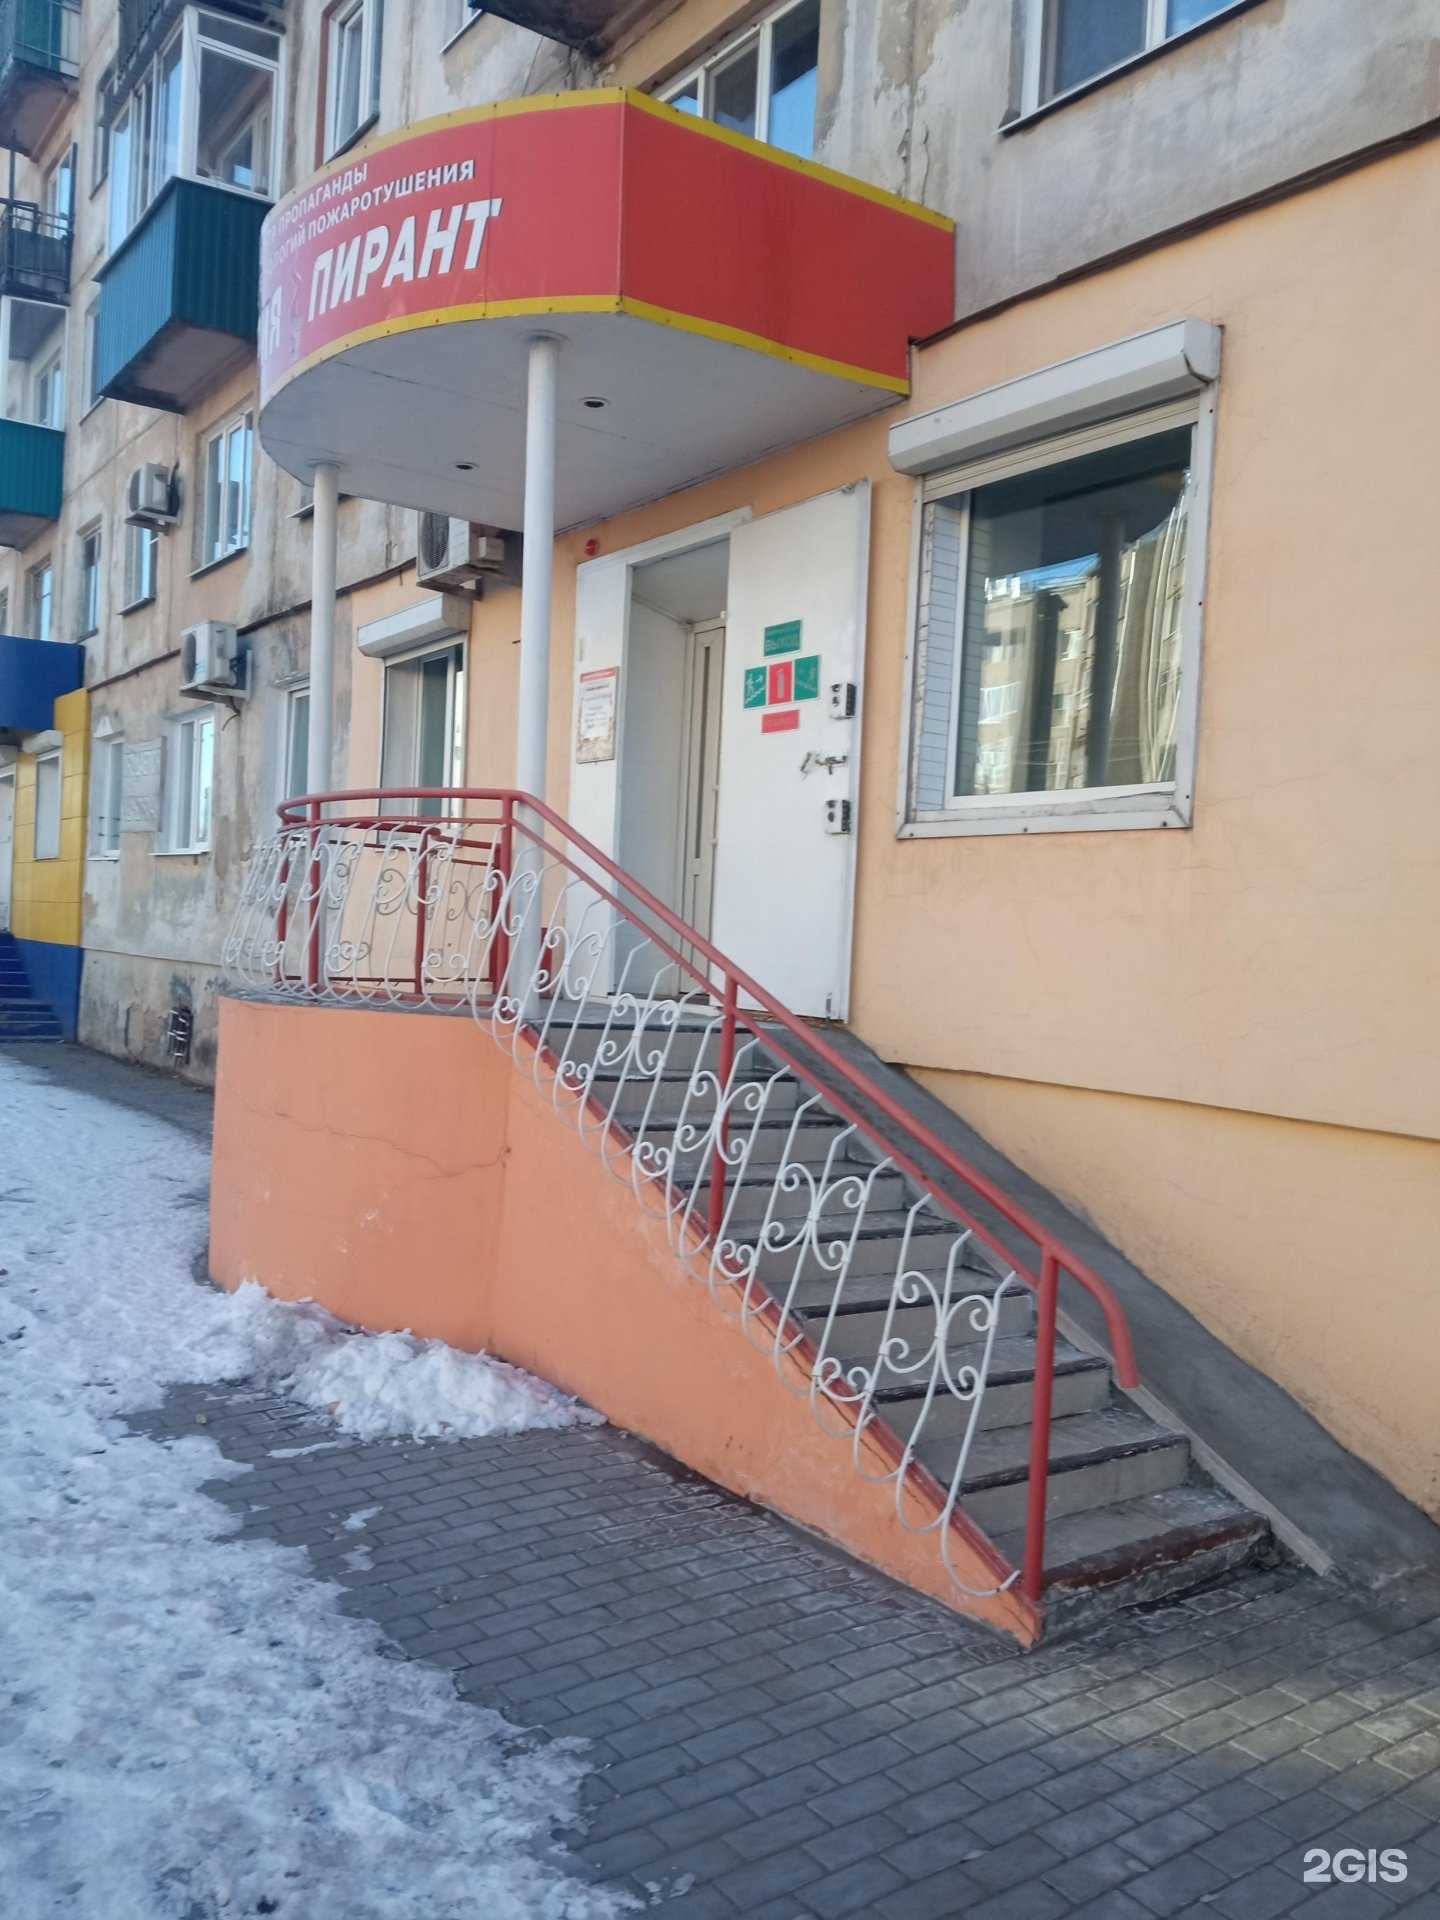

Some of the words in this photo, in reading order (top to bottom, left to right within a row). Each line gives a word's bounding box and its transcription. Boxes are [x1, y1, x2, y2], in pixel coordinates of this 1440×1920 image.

[278, 163, 368, 231] ПРОПАГАНДЫ
[308, 160, 475, 241] ПОЖАРОТУШЕНИЯ
[308, 198, 503, 322] ПИРАНТ
